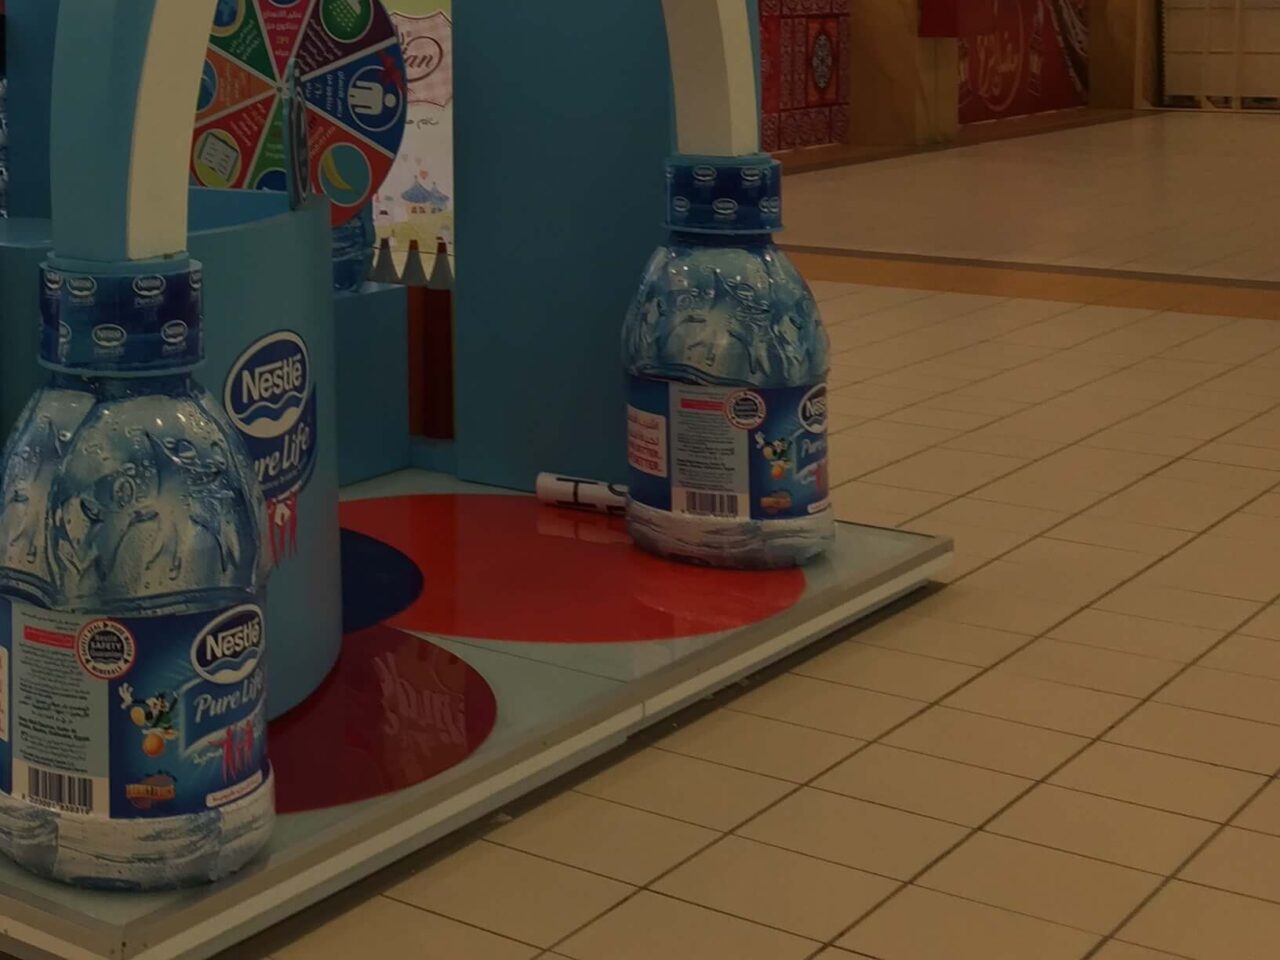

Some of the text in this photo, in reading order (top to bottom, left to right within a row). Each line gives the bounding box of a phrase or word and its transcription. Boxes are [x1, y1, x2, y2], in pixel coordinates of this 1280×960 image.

[241, 352, 302, 404] Nestlé
[282, 421, 310, 471] Life
[90, 641, 122, 651] SAFETY
[193, 693, 239, 724] Pure
